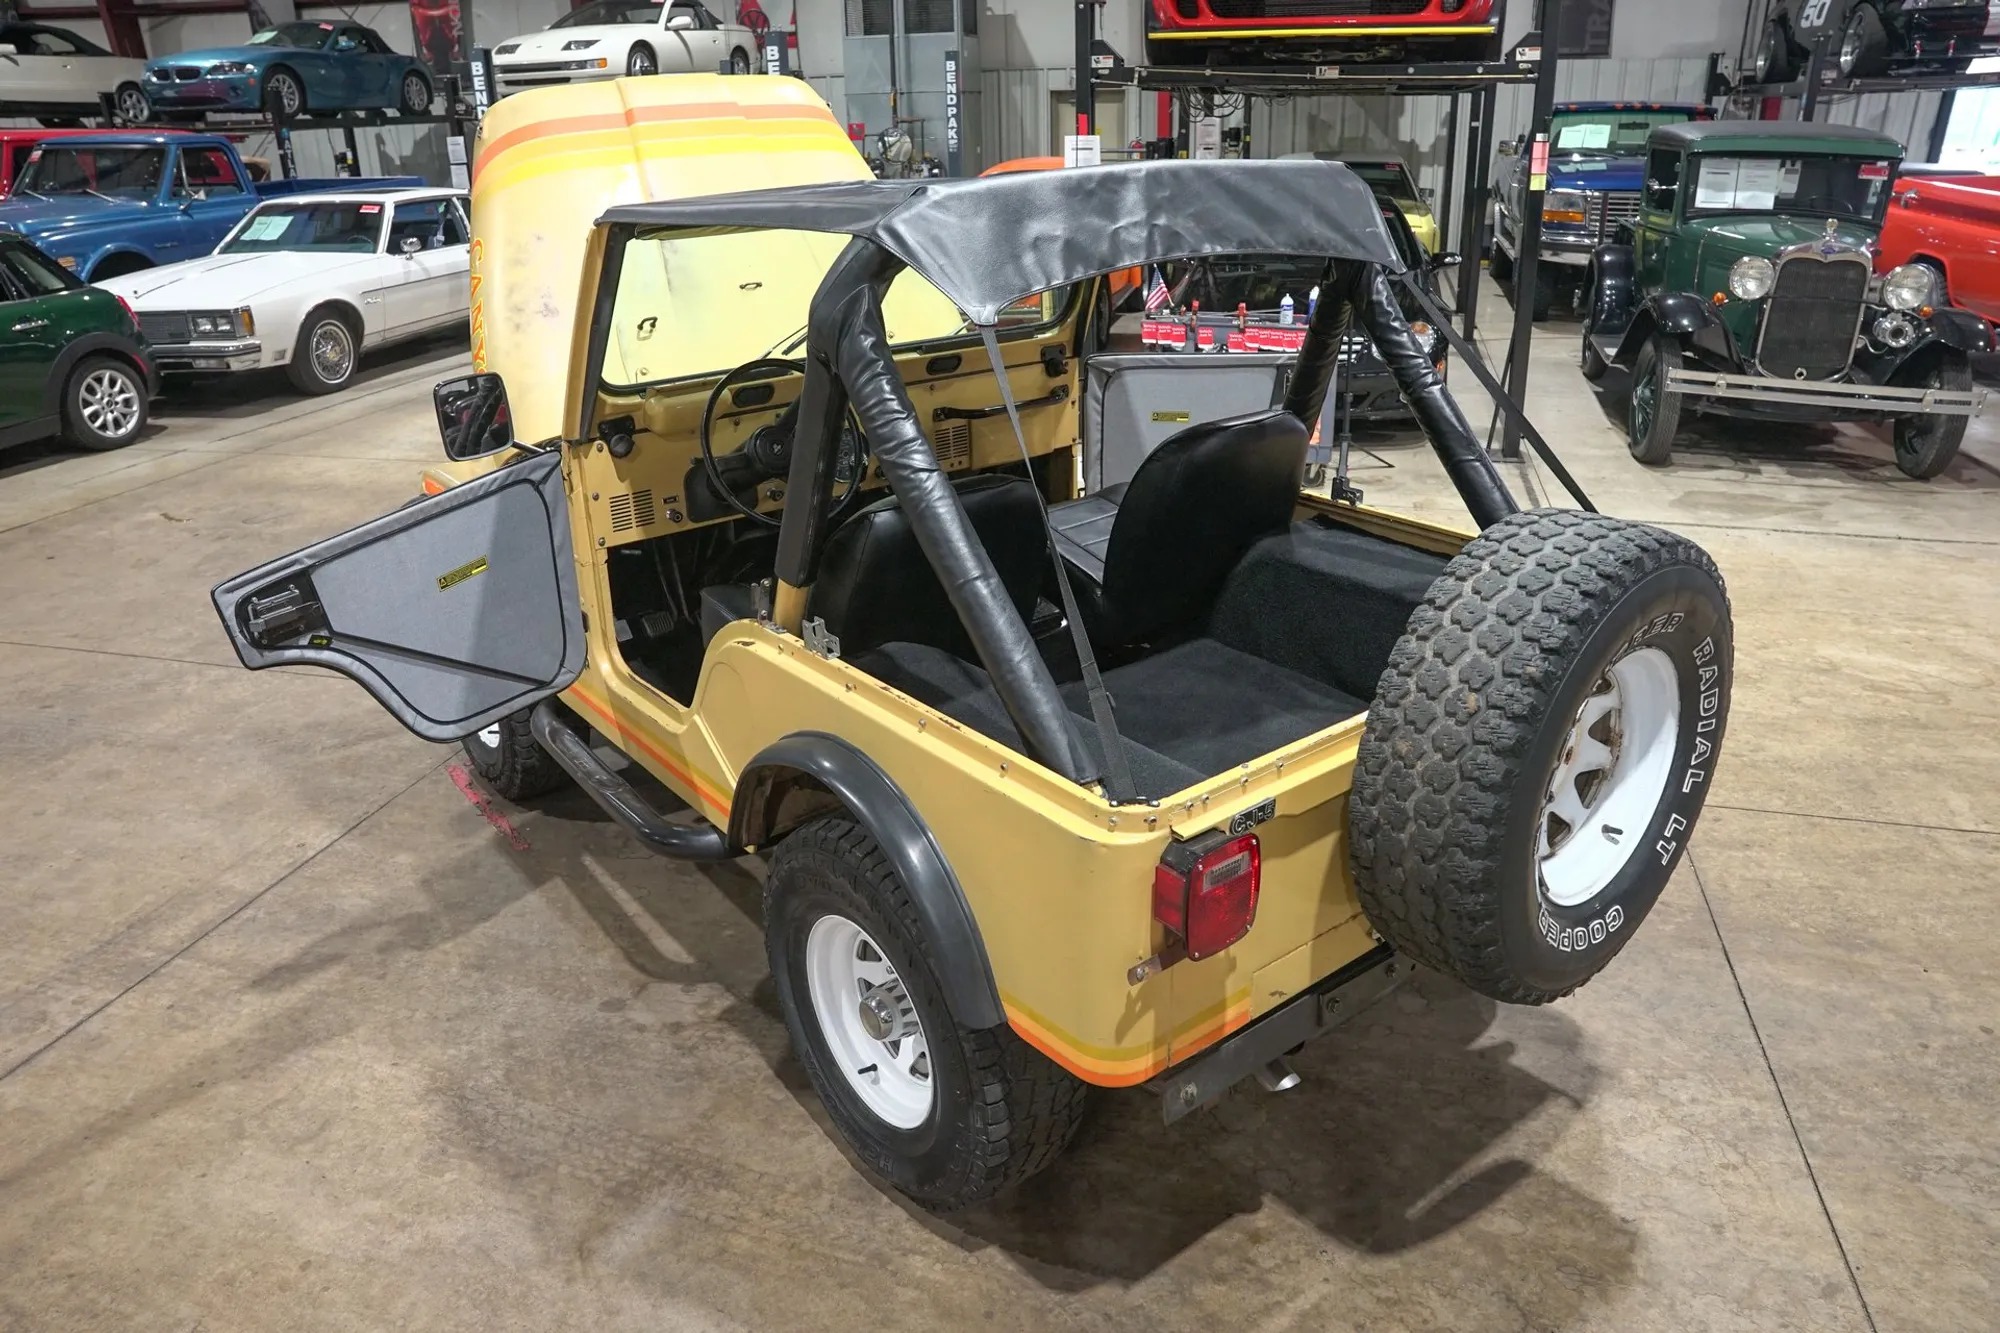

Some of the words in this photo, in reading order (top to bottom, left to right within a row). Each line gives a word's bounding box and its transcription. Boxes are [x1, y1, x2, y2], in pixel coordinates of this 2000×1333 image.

[1801, 0, 1831, 28] 50
[946, 60, 959, 139] BENDPAK
[470, 237, 487, 374] CANY
[1682, 636, 1719, 793] RADIAL
[1231, 801, 1275, 835] CJ-5
[1656, 813, 1687, 866] LT
